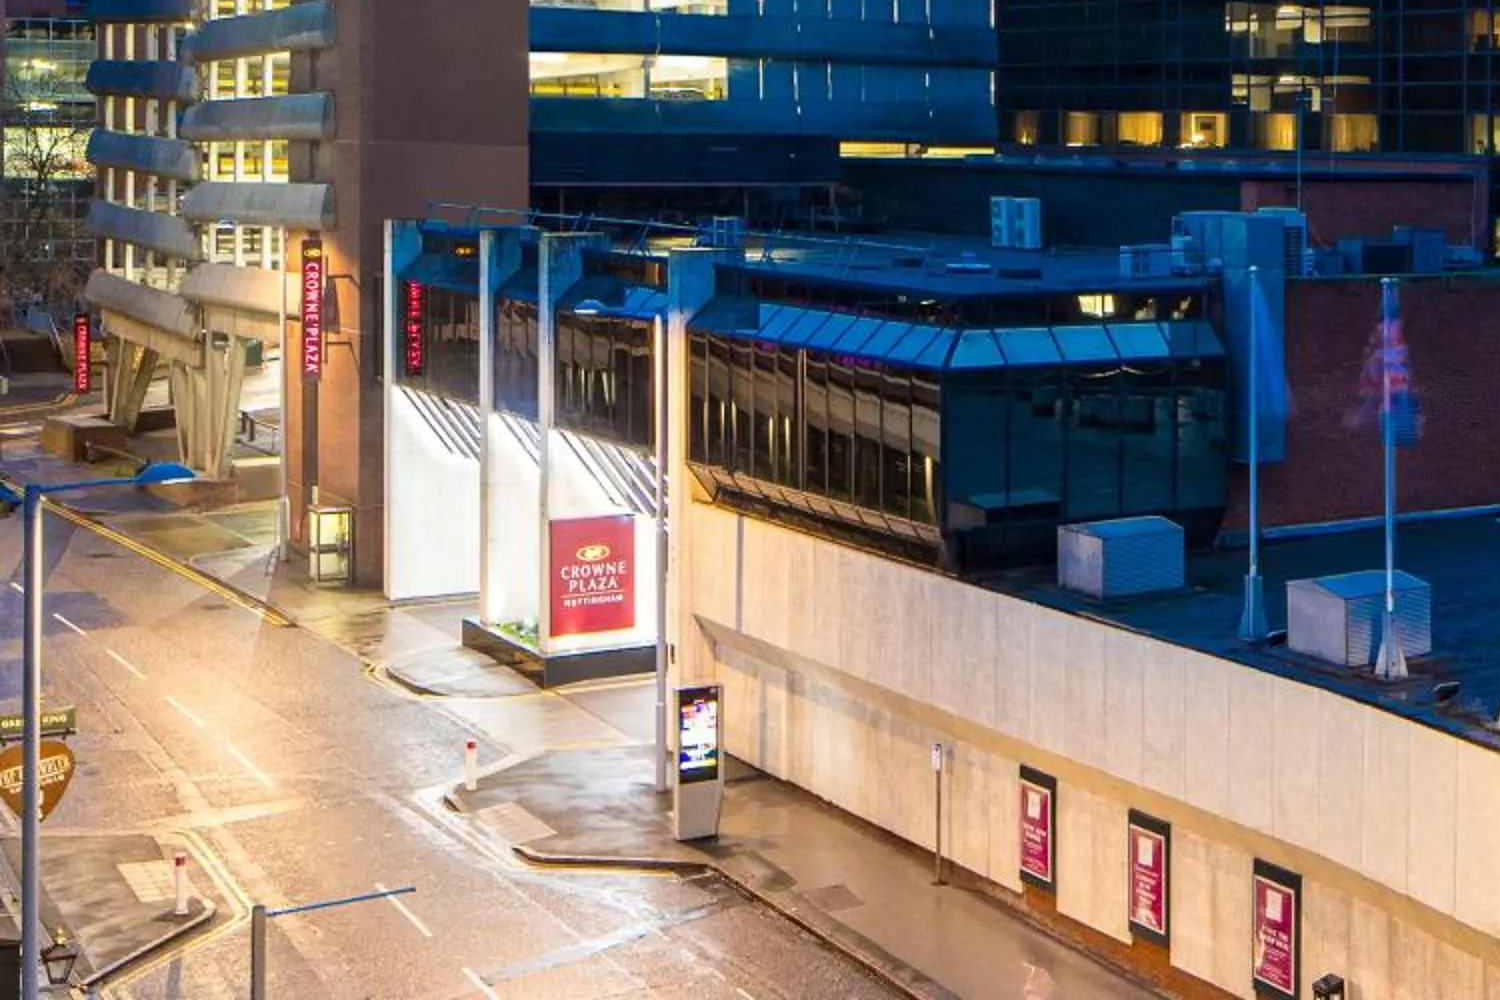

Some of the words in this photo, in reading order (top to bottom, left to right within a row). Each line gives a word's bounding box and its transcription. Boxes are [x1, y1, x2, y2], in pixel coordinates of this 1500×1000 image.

[305, 262, 320, 322] CROWNE
[305, 327, 320, 373] PLAZA
[560, 561, 627, 580] CROWNE
[568, 576, 618, 592] PLAZA
[563, 593, 625, 607] NOTTINGHAM
